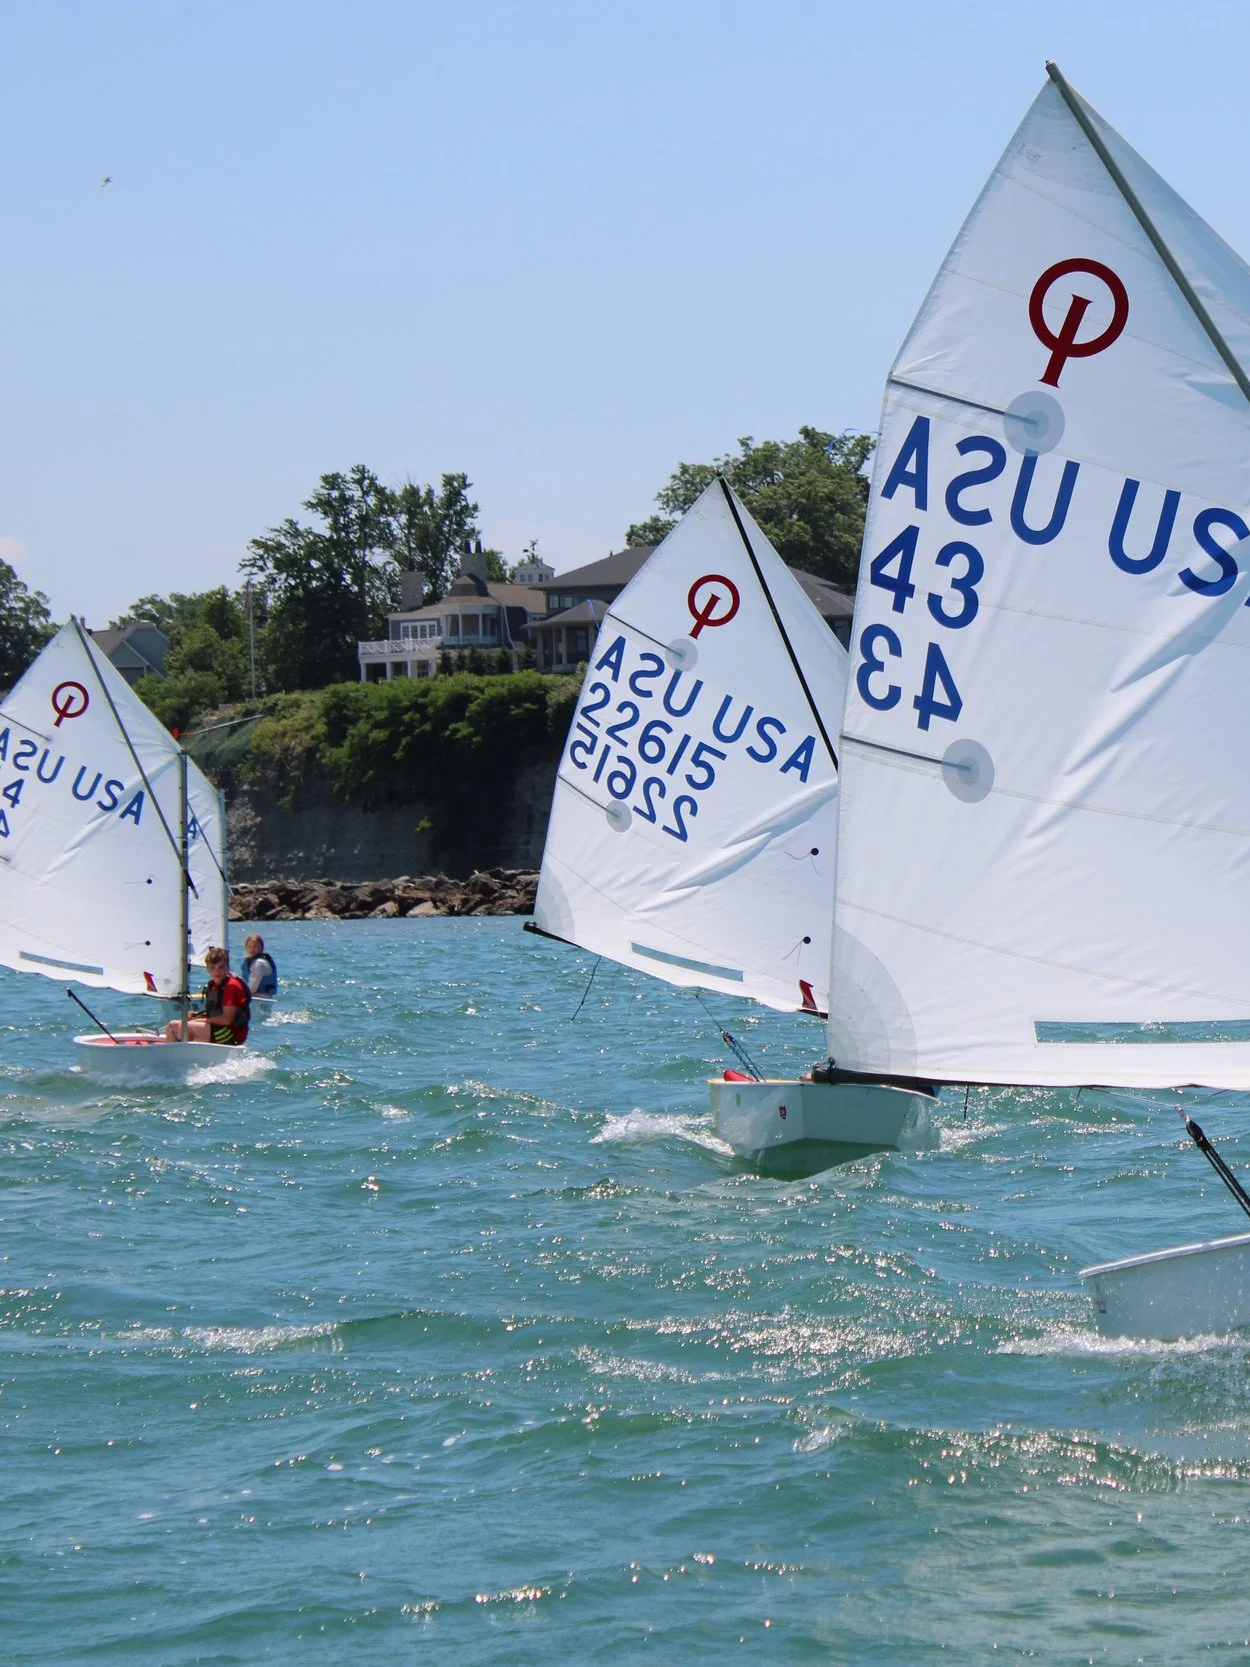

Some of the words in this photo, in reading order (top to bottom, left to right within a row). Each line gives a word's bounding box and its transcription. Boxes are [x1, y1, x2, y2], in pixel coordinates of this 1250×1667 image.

[870, 524, 985, 630] 43
[580, 681, 728, 791] 22615
[712, 694, 816, 784] USA
[72, 765, 145, 826] USA
